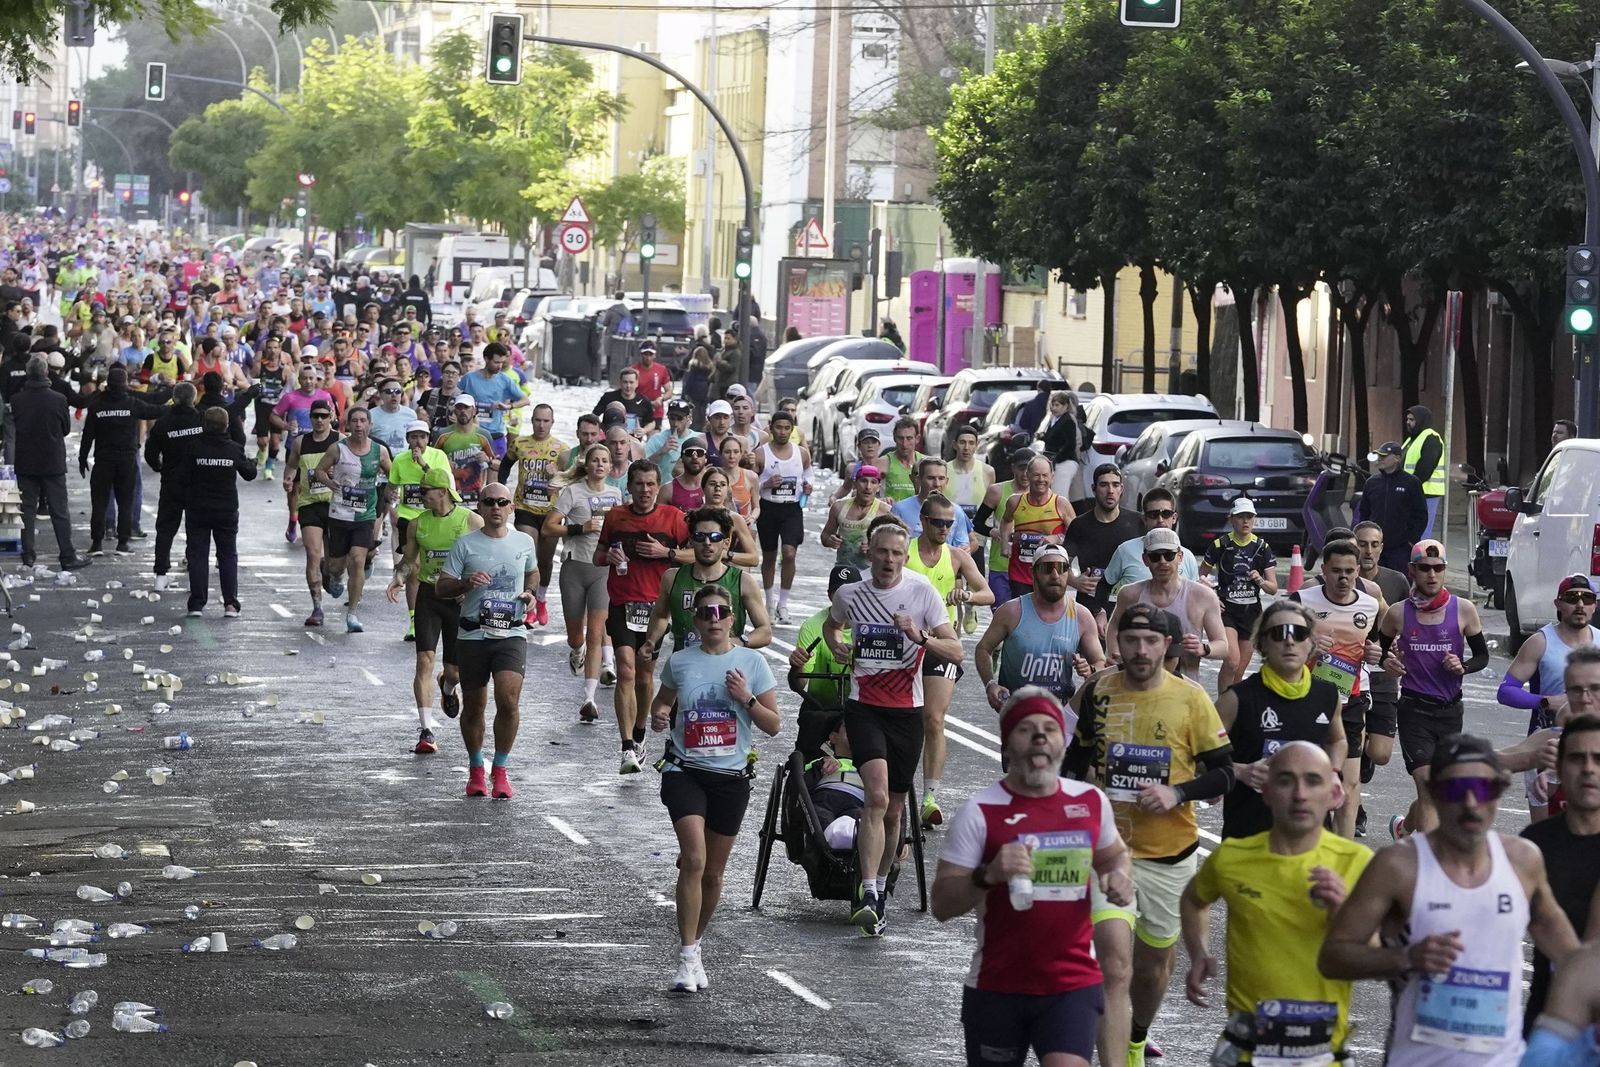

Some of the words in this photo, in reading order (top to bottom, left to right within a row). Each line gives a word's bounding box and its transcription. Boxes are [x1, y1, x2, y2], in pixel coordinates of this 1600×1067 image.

[566, 233, 584, 244] 30
[96, 409, 131, 418] VOLUNTEER
[167, 427, 203, 438] VOLUNTEER
[196, 458, 234, 467] VOLUNTEER
[1267, 519, 1285, 528] GBR
[485, 619, 511, 629] SERGEY
[872, 639, 887, 647] 4326
[1409, 643, 1453, 651] TOULOUSE
[861, 648, 897, 659] MARTEL
[1332, 659, 1357, 674] ZURICH
[701, 711, 730, 719] ZURICH
[702, 724, 719, 733] 1396
[698, 735, 724, 746] JANA
[1127, 747, 1164, 758] ZURICH
[1127, 764, 1148, 774] 4915
[1044, 837, 1084, 846] ZURICH
[1032, 867, 1079, 884] JULIÁN
[1497, 894, 1513, 914] B
[1286, 1003, 1330, 1015] ZURICH
